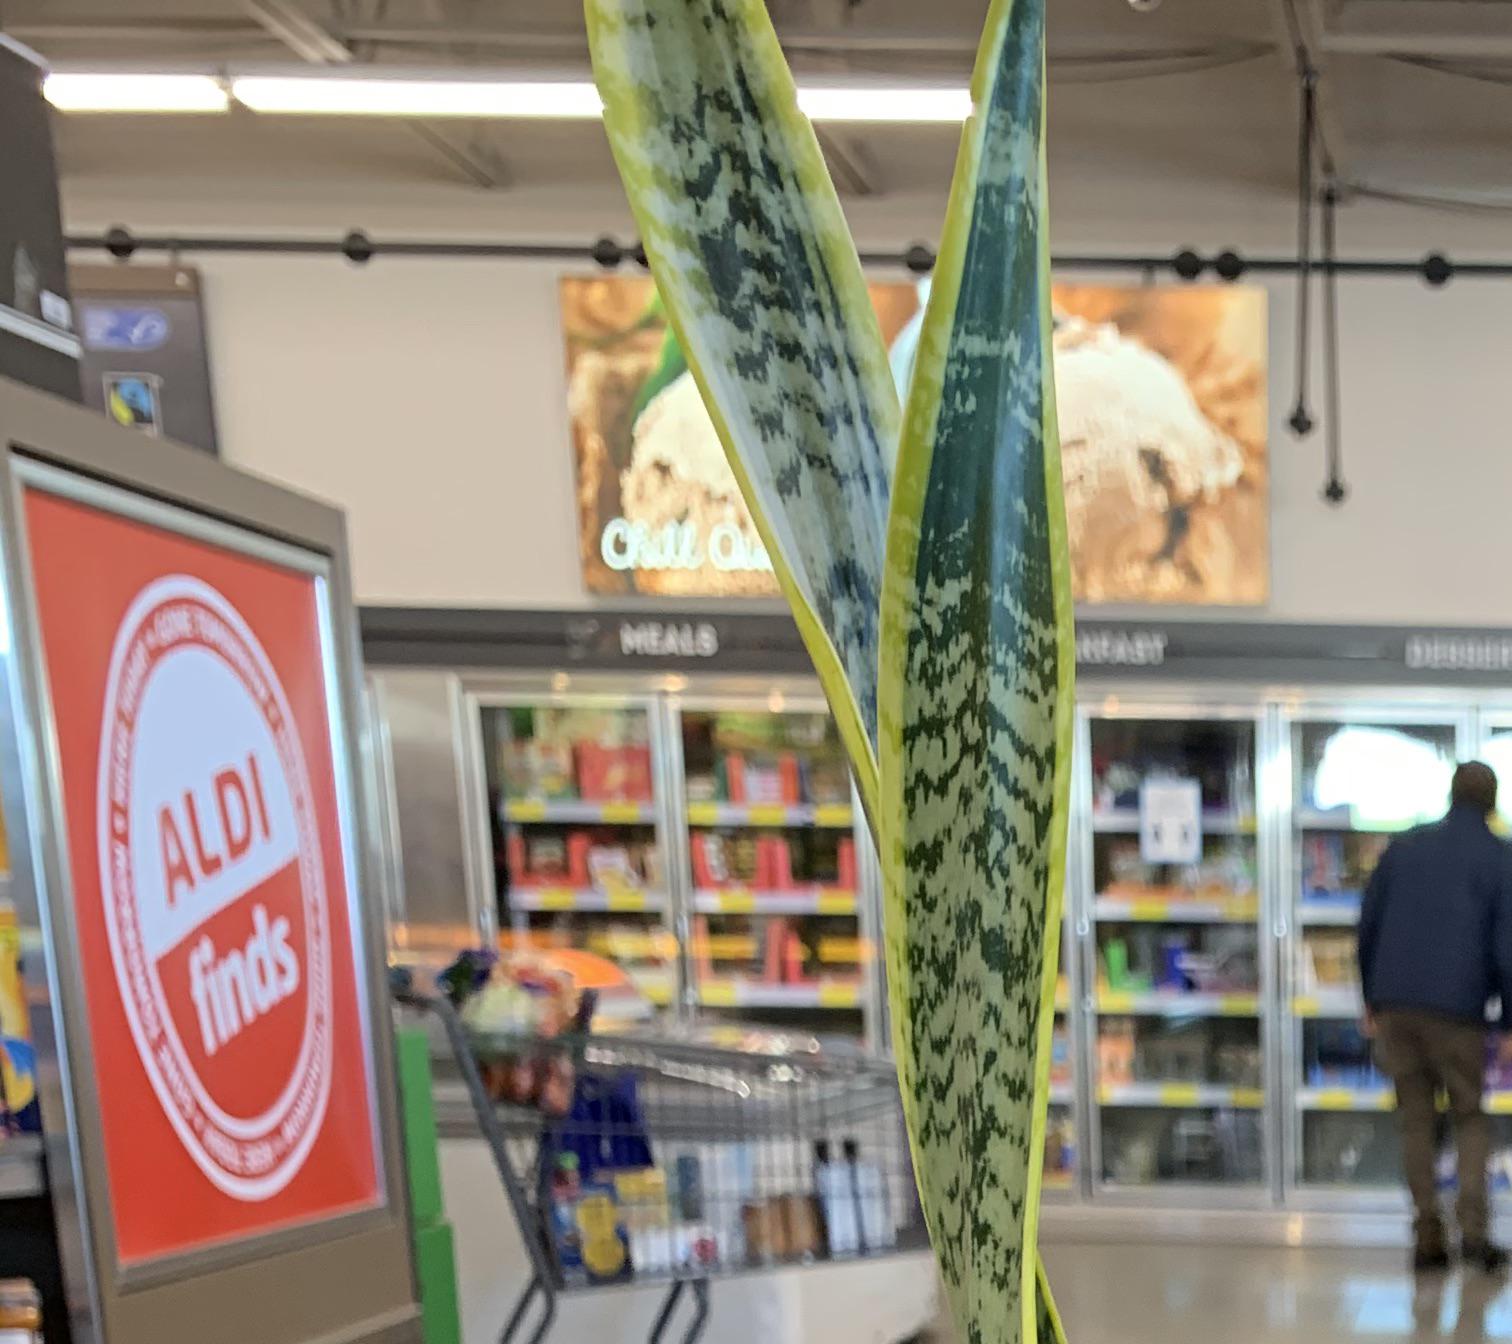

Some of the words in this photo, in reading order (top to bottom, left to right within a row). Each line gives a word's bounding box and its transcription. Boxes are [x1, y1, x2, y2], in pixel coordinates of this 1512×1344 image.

[620, 622, 719, 657] MEALS
[157, 752, 273, 905] ALDI
[189, 903, 300, 1056] finds
